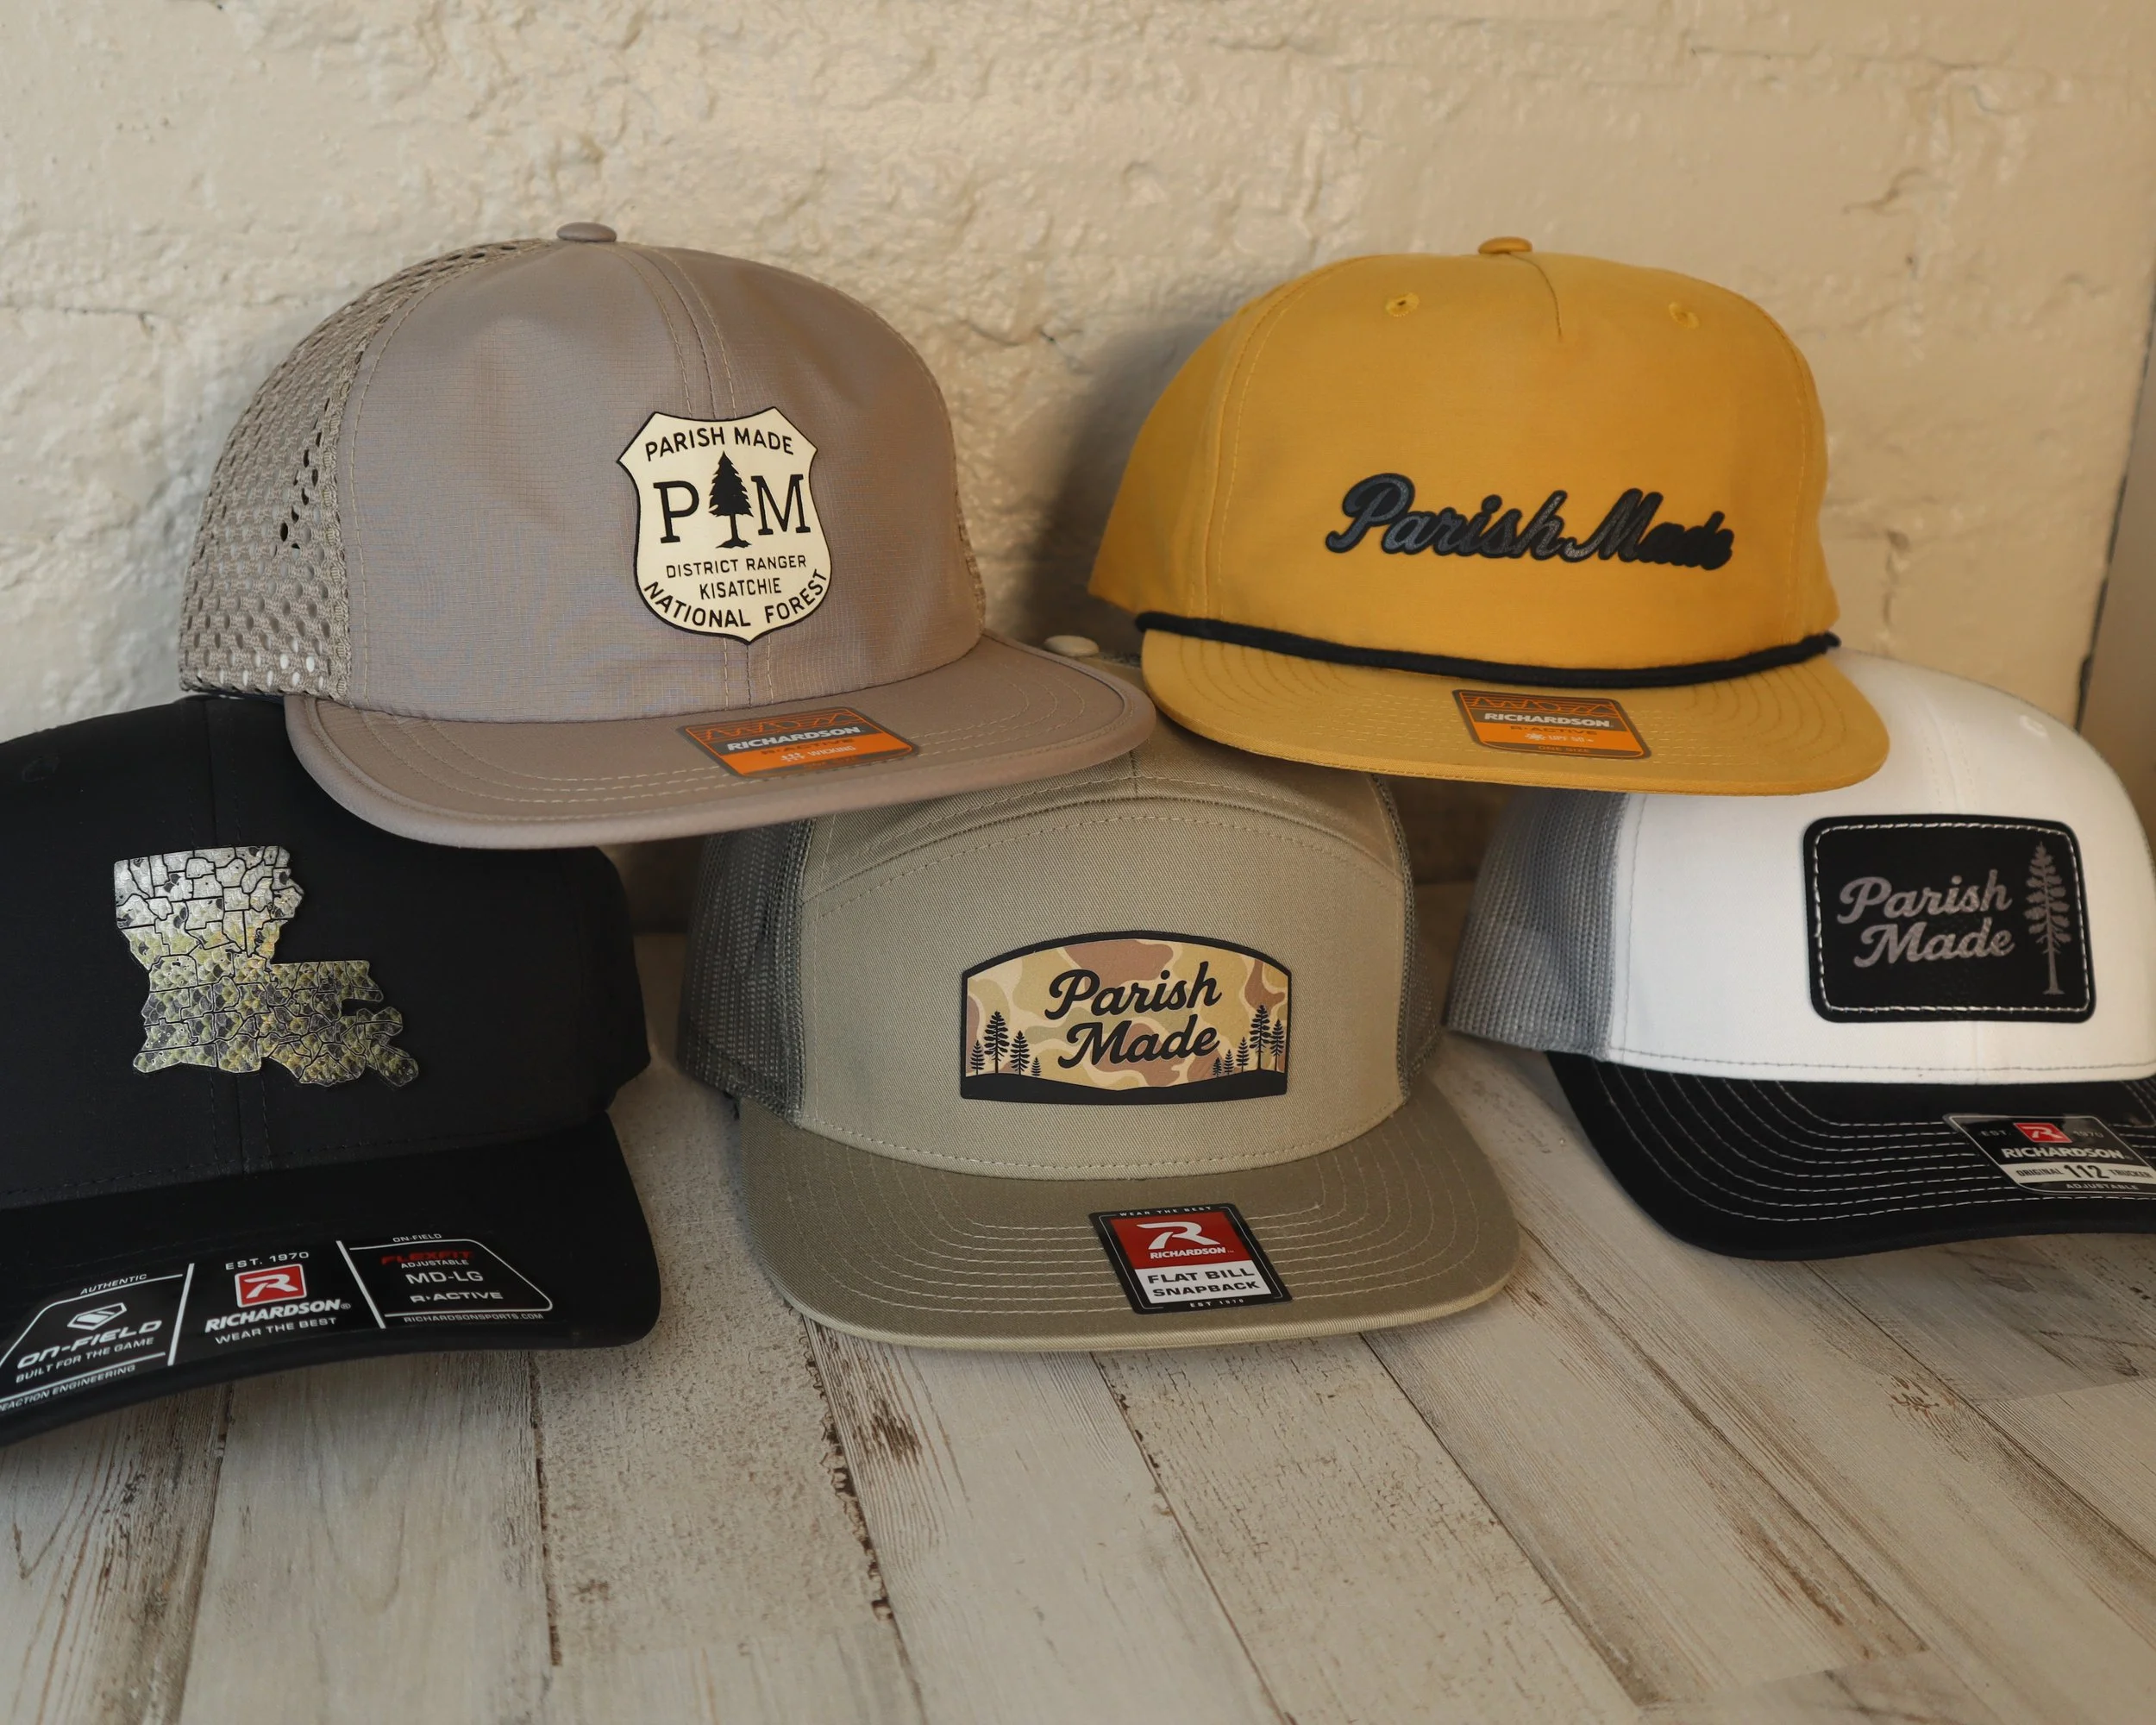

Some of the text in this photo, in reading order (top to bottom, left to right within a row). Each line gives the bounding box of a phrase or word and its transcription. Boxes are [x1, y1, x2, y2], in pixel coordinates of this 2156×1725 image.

[645, 426, 794, 462] PARISH MADE
[653, 474, 812, 544] P M
[1326, 473, 1564, 561] Parish
[666, 555, 807, 579] DISTRICT RANGER
[643, 568, 827, 628] NATIONAL FOREST
[699, 577, 782, 600] KISATCHIE
[1483, 712, 1611, 728] RICHARDSON
[727, 726, 862, 751] RICHARDSON
[1836, 869, 2014, 925] Parish
[1853, 916, 2015, 969] Made
[1044, 961, 1223, 1021] Parish
[1057, 1014, 1220, 1069] Made
[2002, 1147, 2125, 1160] RICHARDSON
[2015, 1164, 2154, 1179] ORIGINAL 112 TRUCKER
[392, 1233, 442, 1244] ON-FIELD
[225, 1251, 310, 1270] EST. 1970
[380, 1251, 473, 1265] FLEXFIT
[1150, 1246, 1226, 1259] RICHARDSON
[401, 1259, 470, 1270] ADJUSTABLE
[1147, 1268, 1255, 1284] FLAT BILL
[80, 1273, 147, 1295] AUTHENTIC
[405, 1270, 485, 1285] MD-LG
[1152, 1281, 1261, 1297] SNAPBACK
[404, 1312, 545, 1324] RICHARDSONSPORTS.COM
[215, 1317, 337, 1346] WEAR THE BEST
[16, 1337, 154, 1384] BUILT FOR THE GAME
[52, 1364, 136, 1396] ENGINEERING
